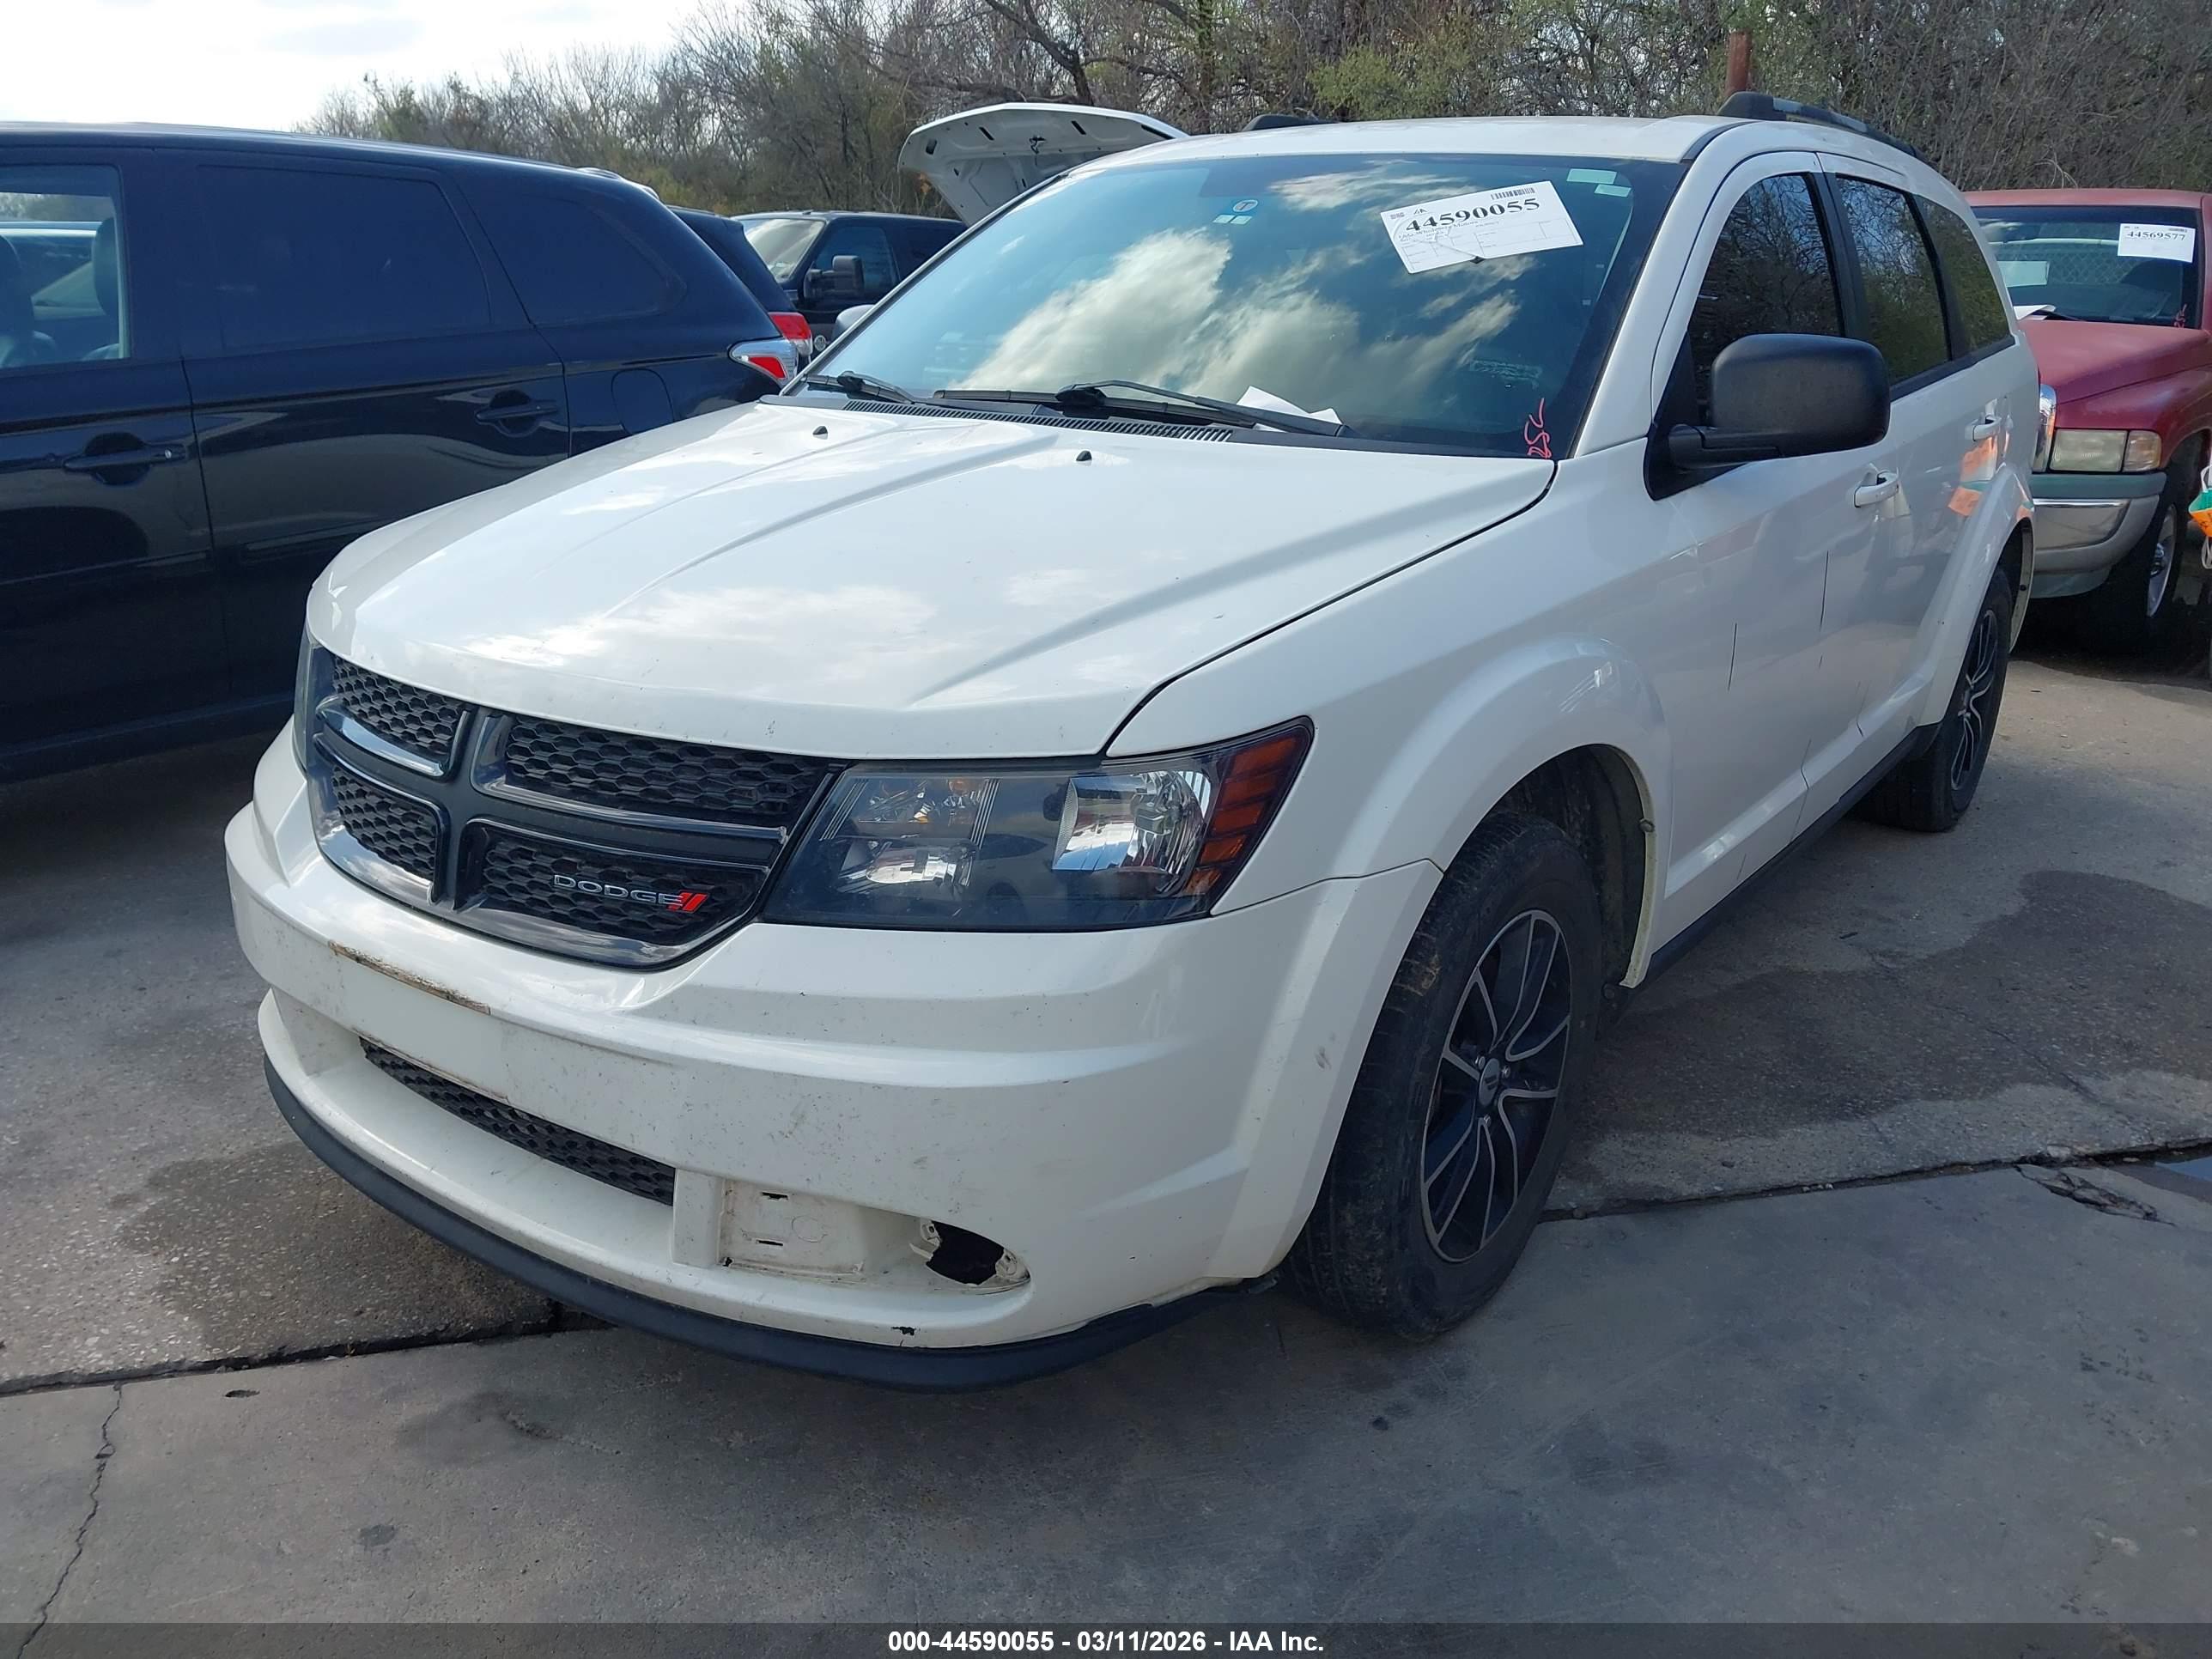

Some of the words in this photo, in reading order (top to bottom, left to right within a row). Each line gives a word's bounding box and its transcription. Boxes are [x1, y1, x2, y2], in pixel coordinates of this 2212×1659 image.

[1406, 198, 1540, 232] 44590055
[2127, 230, 2186, 241] 44569577
[553, 874, 684, 907] DODGE
